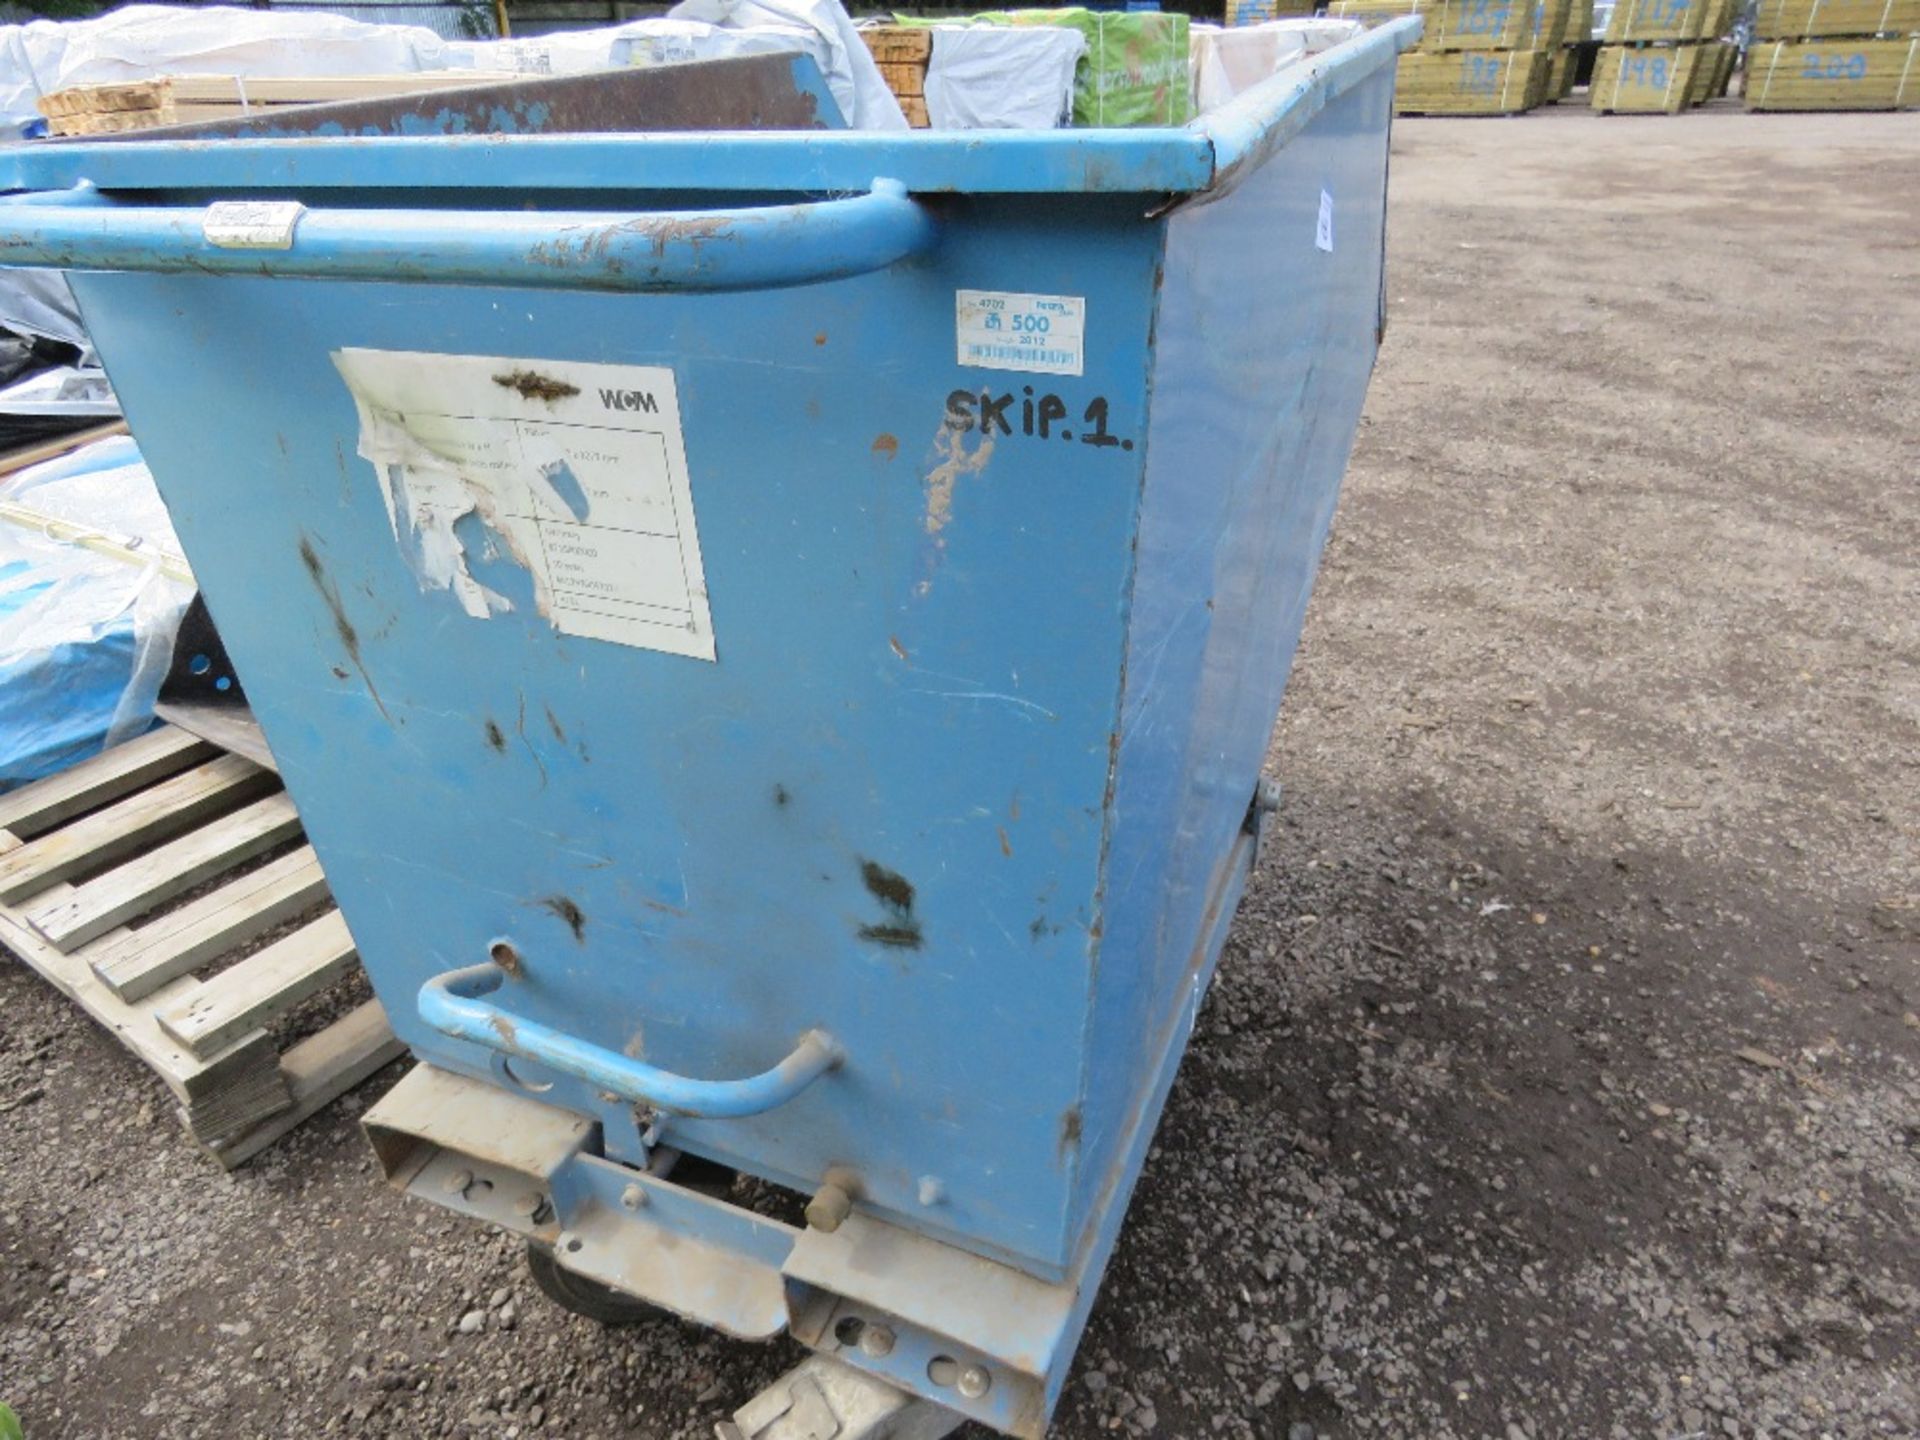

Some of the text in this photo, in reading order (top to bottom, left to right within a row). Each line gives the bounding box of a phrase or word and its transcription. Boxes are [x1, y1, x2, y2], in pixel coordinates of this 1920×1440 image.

[1802, 53, 1868, 80] 200
[1011, 313, 1050, 333] 500
[1019, 335, 1045, 346] 2012
